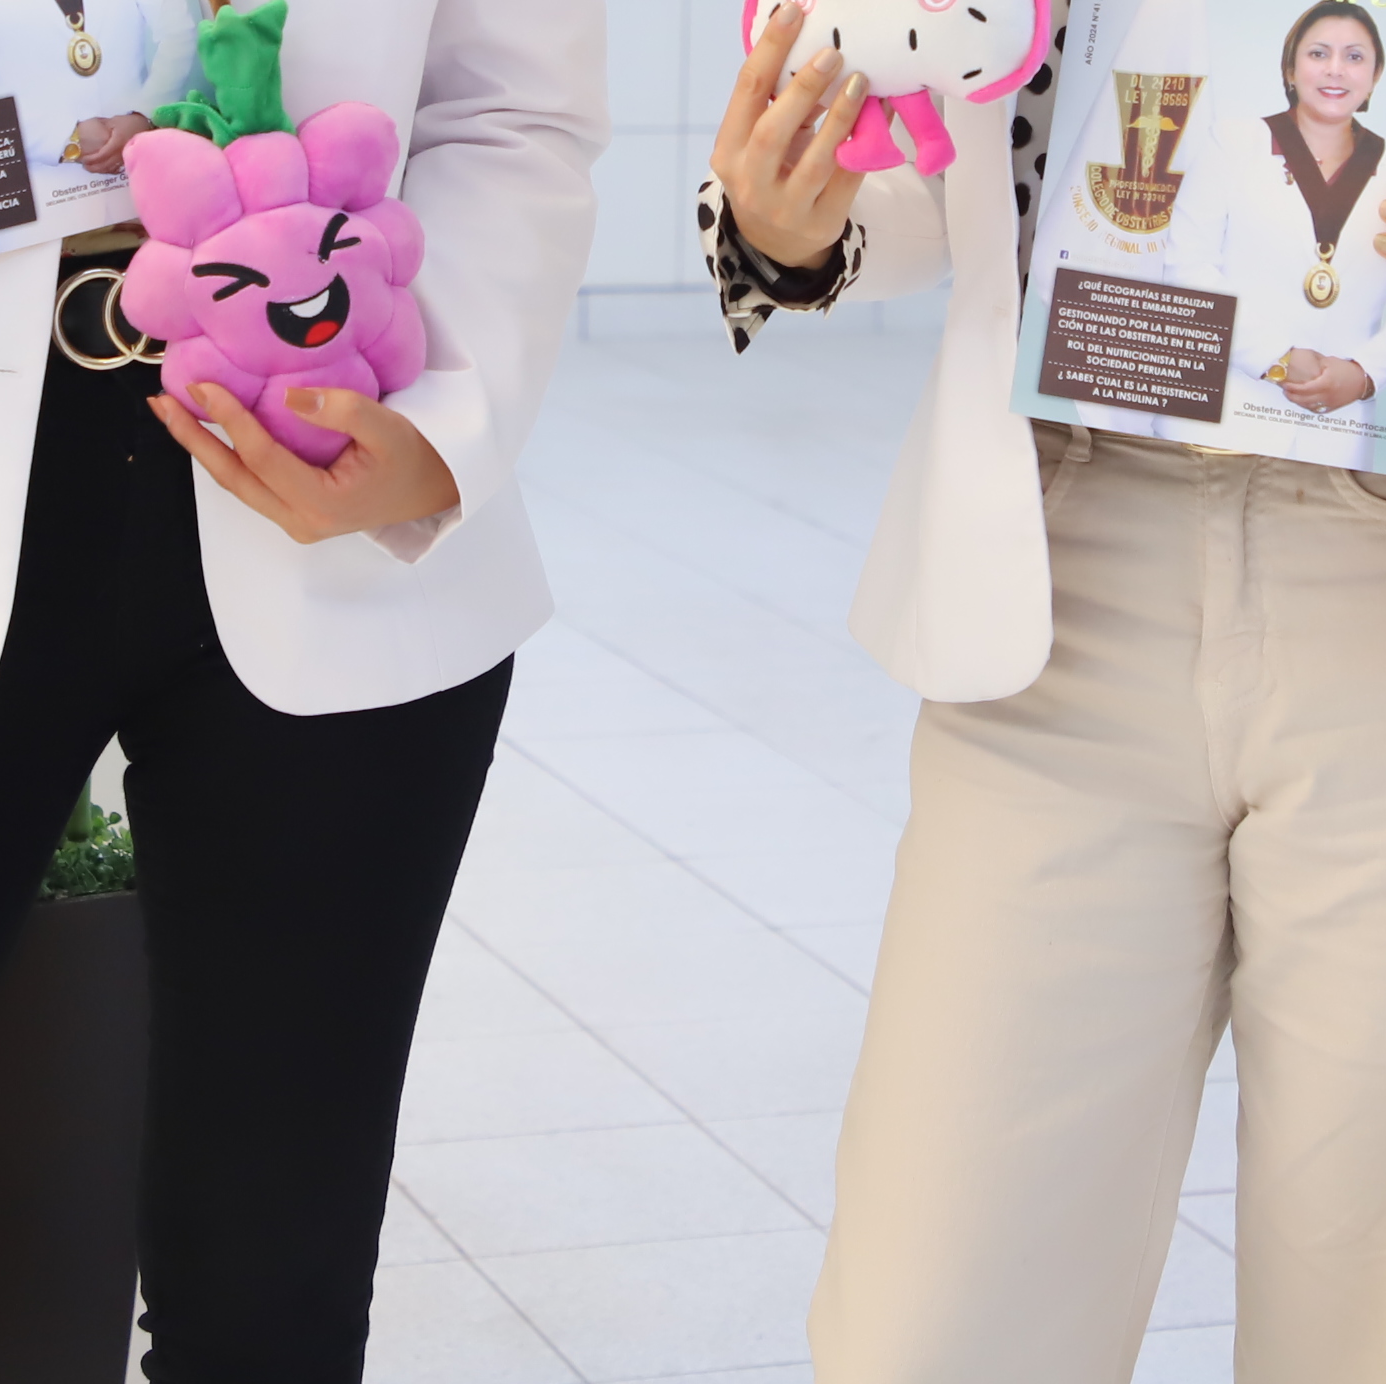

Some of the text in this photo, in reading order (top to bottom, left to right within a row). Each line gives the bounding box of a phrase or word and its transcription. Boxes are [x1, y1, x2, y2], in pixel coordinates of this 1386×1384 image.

[1088, 24, 1097, 44] 2024
[1085, 45, 1094, 65] AÑO
[1130, 75, 1145, 89] DL
[1125, 90, 1189, 106] LEY 28686
[52, 177, 117, 198] Obstetra Ginger
[1091, 166, 1109, 207] COLEGIO
[1104, 204, 1119, 218] DE
[1116, 189, 1131, 199] LEY
[1078, 280, 1215, 309] ¿QUÉ ECOGRAFÍAS SE REALIZAN
[1090, 293, 1196, 318] DURANTE EL EMBARAZO?
[1058, 307, 1223, 342] GESTIONANDO POR LA REIVINDICA-
[1058, 319, 1221, 354] CIÓN DE LAS OBSTETRAS EN EL PERÚ
[1067, 340, 1205, 371] ROL DEL NUTRICIONISTA EN LA
[1086, 355, 1182, 379] SOCIEDAD PERUANA
[1066, 370, 1095, 384] SABES
[1096, 377, 1122, 388] CUAL
[1124, 381, 1135, 390] ES
[1136, 382, 1148, 393] LA
[1151, 385, 1209, 403] RESISTENCIA
[1092, 388, 1168, 408] A LA INSULINA ?
[1243, 402, 1281, 415] Obstetra
[1284, 410, 1315, 421] Ginger
[1294, 421, 1321, 429] REGIONAL
[1331, 427, 1363, 436] OBSTETRAS
